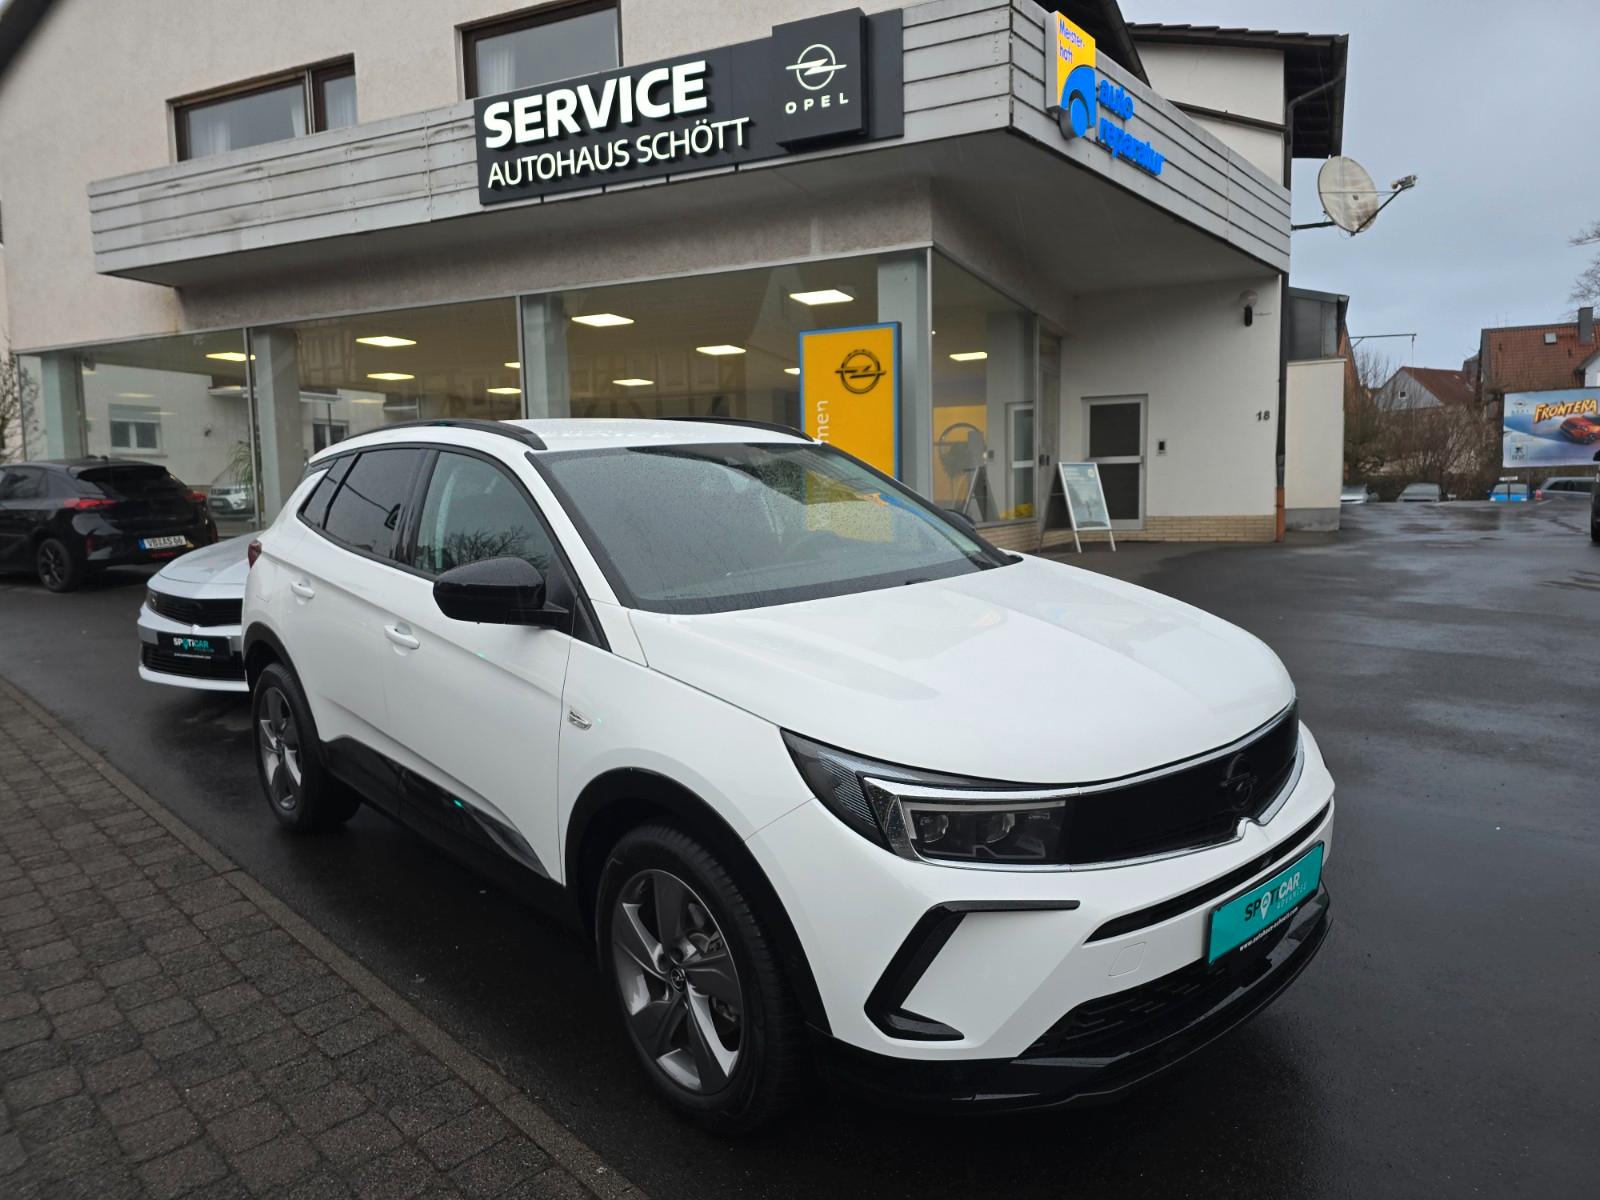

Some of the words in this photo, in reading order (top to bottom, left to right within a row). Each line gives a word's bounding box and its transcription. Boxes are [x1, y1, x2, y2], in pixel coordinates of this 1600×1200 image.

[483, 60, 708, 150] SERVICE
[785, 92, 849, 115] OPEL
[1100, 79, 1134, 120] auto
[487, 136, 631, 188] AUTOHAUS
[636, 116, 751, 165] SCHÖTT
[1255, 410, 1271, 422] 18
[1534, 399, 1599, 424] FRONTERA
